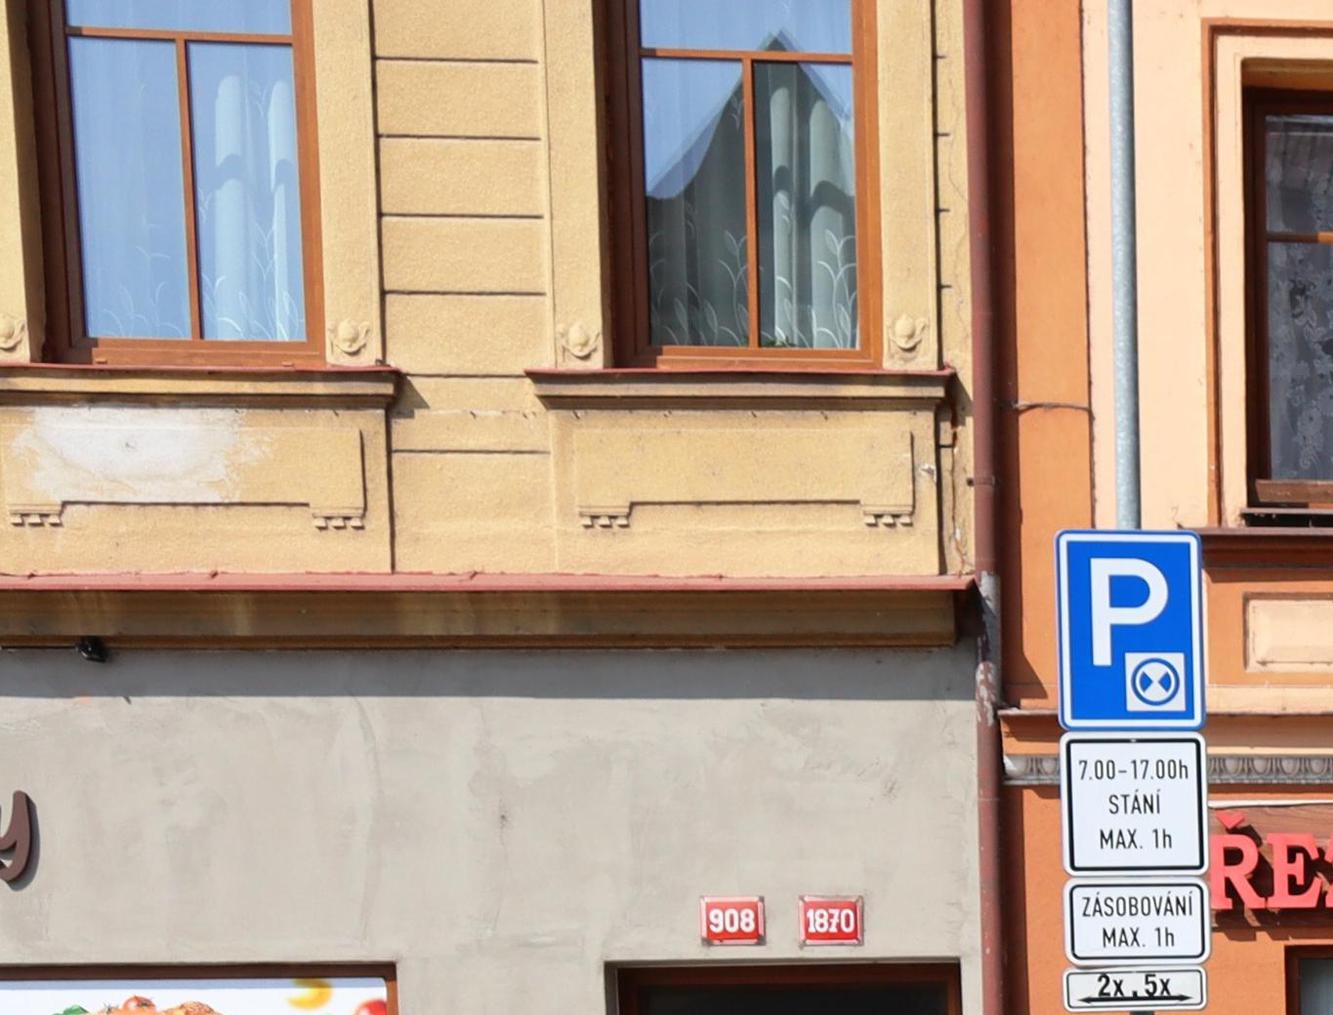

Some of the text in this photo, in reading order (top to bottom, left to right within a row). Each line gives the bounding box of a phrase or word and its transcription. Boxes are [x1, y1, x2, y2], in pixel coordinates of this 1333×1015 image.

[1090, 558, 1169, 667] P
[1078, 759, 1189, 780] 7.00-17.00h
[1108, 788, 1161, 815] STÁNÍ
[1099, 828, 1172, 849] MAX. 1h
[1081, 890, 1193, 917] ZÁSOBOVÁNÍ
[709, 908, 755, 933] 908
[807, 908, 855, 933] 1870
[1102, 926, 1175, 948] MAX. 1h
